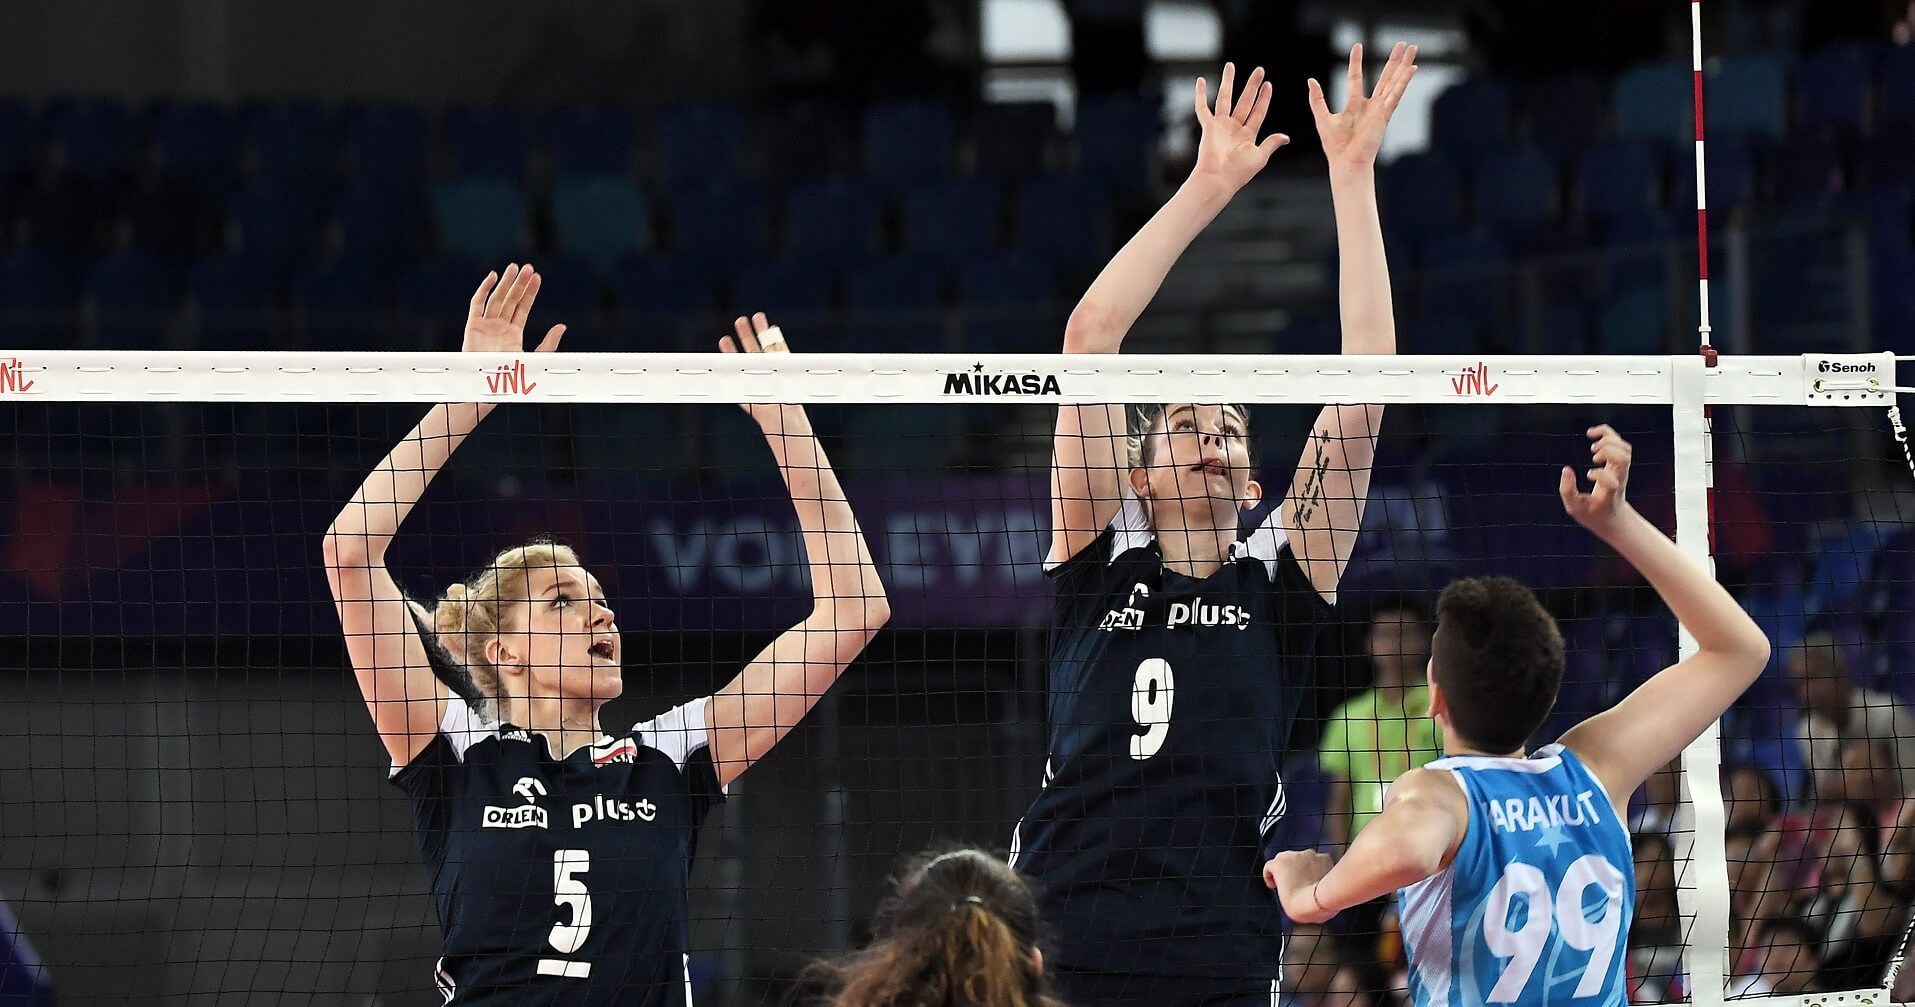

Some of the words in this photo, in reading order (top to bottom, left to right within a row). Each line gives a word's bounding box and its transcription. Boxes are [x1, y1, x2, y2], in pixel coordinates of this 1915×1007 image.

[0, 357, 35, 393] NL
[943, 371, 1062, 396] MIKASA
[1831, 362, 1876, 373] Senoh
[1129, 657, 1175, 761] 9
[485, 806, 546, 827] ORLEN
[572, 794, 636, 829] plus
[547, 848, 593, 955] 5
[1483, 854, 1625, 1004] 99
